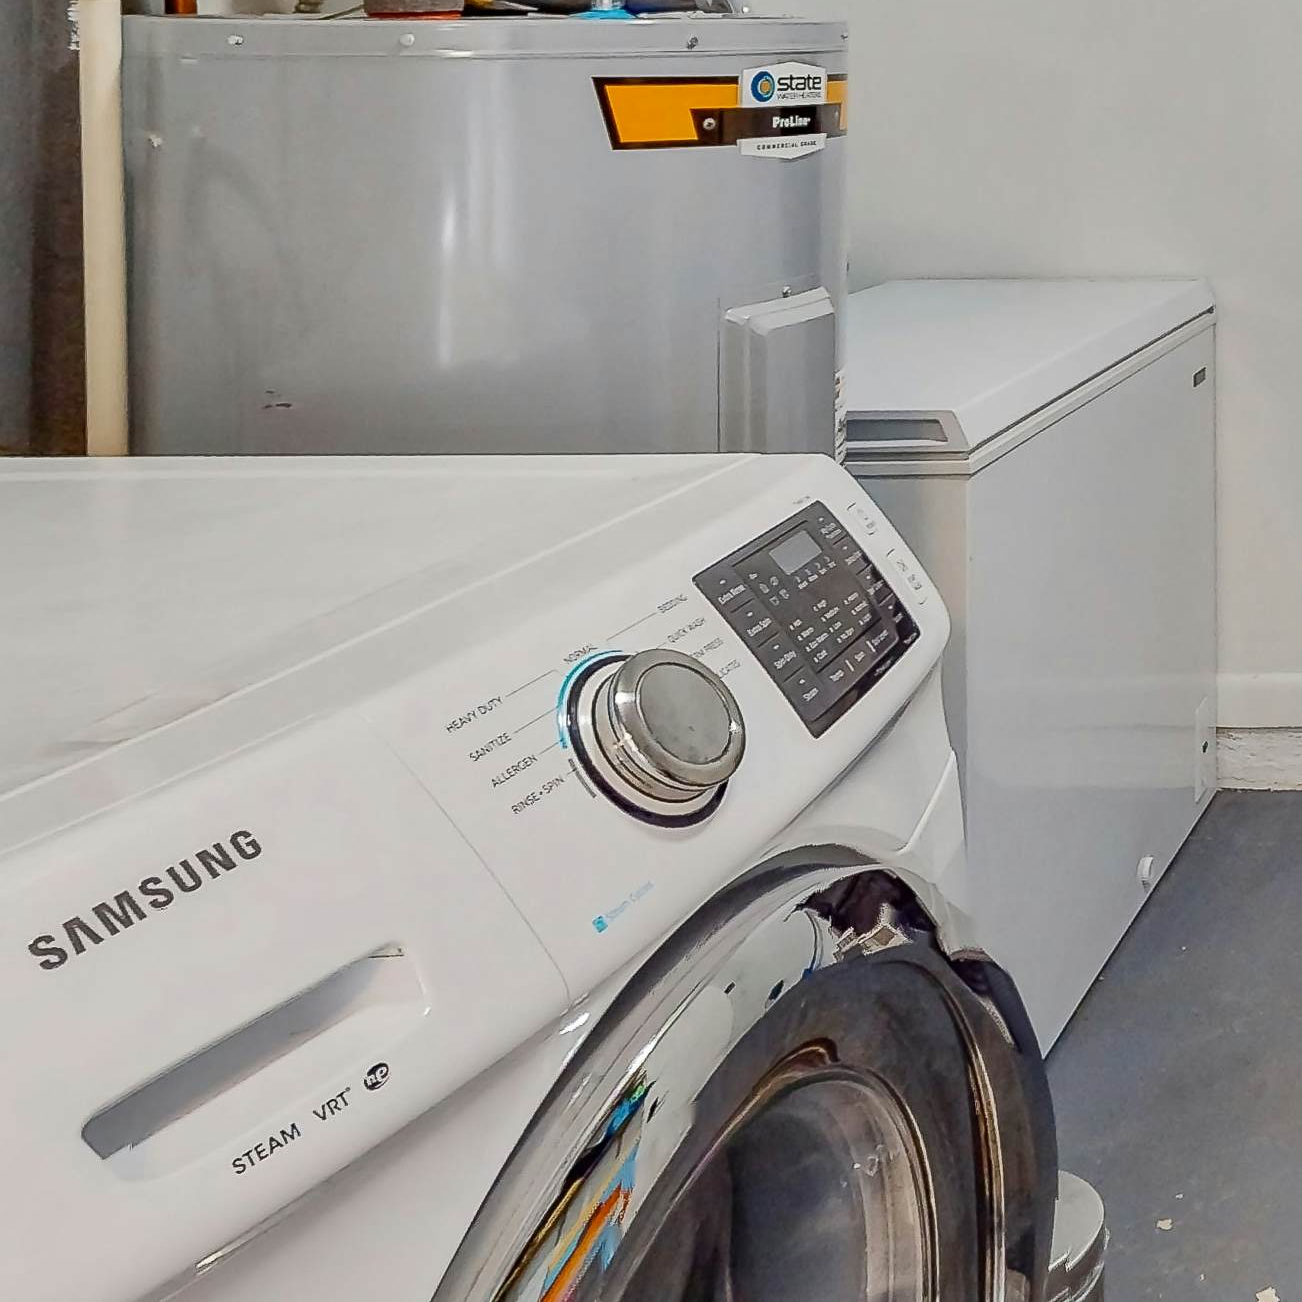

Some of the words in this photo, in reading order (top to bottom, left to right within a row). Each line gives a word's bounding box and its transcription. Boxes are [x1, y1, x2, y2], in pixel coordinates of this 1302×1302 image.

[777, 74, 822, 92] state
[446, 710, 478, 734] HEAVY
[477, 696, 503, 715] DUTY
[469, 732, 512, 762] SANITIZE
[491, 754, 538, 788] ALLERGEN
[27, 829, 263, 971] SAMSUNG
[231, 1122, 302, 1175] STEAM
